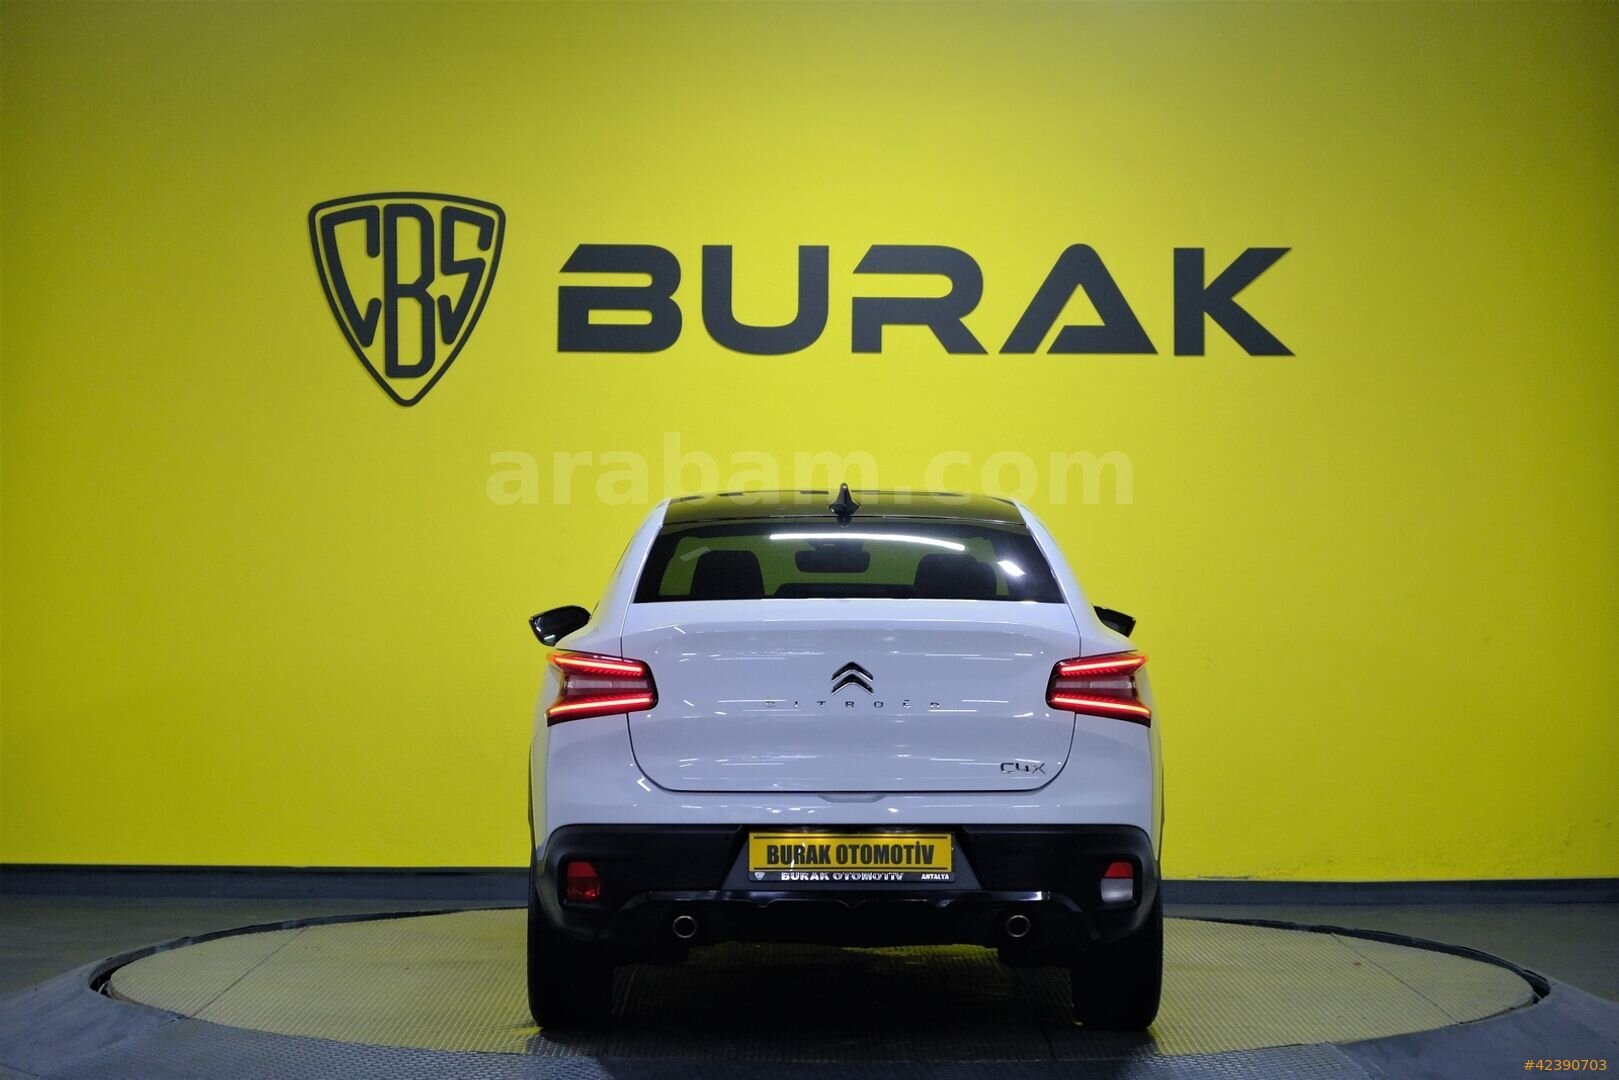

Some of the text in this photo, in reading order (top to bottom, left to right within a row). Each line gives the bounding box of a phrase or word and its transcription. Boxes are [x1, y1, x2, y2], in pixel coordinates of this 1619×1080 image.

[320, 203, 496, 379] CBS
[558, 243, 1294, 356] BURAK
[766, 841, 934, 865] BURAK OTOMOTİV
[781, 871, 830, 881] BURAK
[920, 873, 950, 881] ANTALYA
